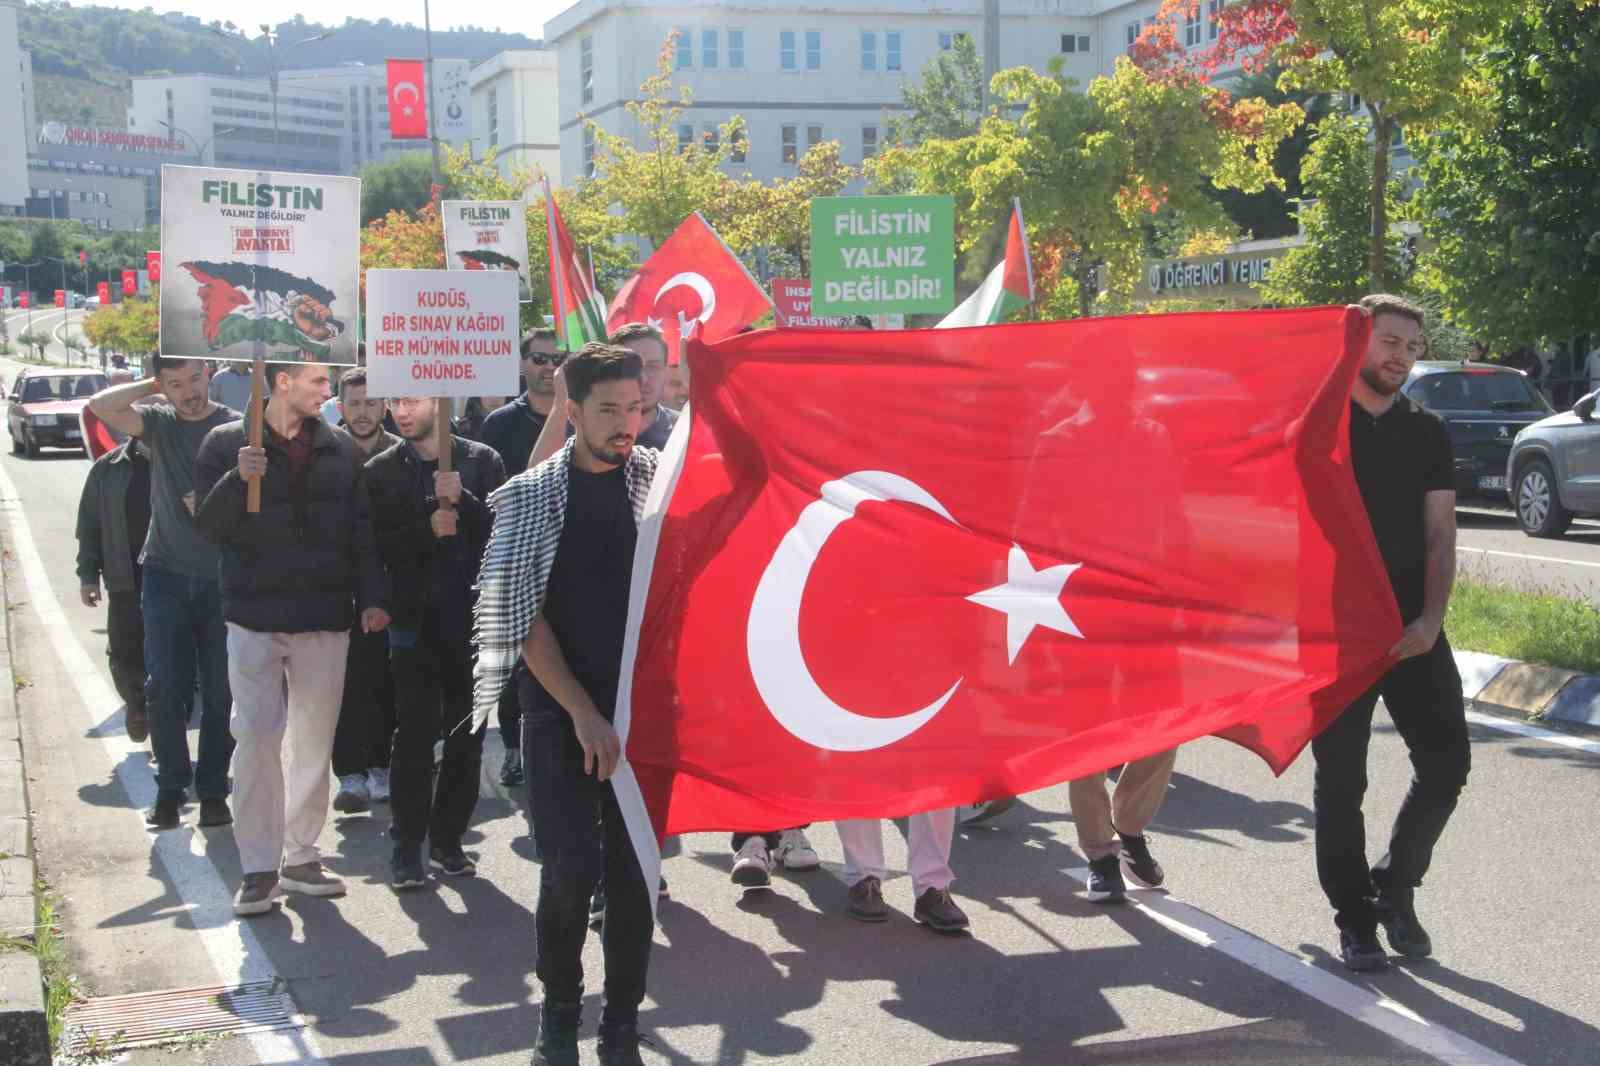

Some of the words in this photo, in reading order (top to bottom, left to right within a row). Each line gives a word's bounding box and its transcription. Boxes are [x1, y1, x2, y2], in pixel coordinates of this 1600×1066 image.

[220, 208, 254, 219] YALNIZ
[835, 209, 931, 235] FİLİSTİN
[841, 246, 926, 268] YALNIZ
[1165, 260, 1224, 288] ÖĞRENCİ
[418, 288, 470, 309] KUDÜS,
[825, 274, 942, 303] DEĞİLDİR!
[382, 312, 406, 331] BİR
[409, 316, 452, 331] SINAV
[456, 312, 504, 331] KAĞIDI
[375, 340, 404, 356] HER
[408, 336, 460, 356] MÜ'MİN
[464, 340, 512, 356] KULUN
[412, 360, 476, 379] ÖNÜNDE.
